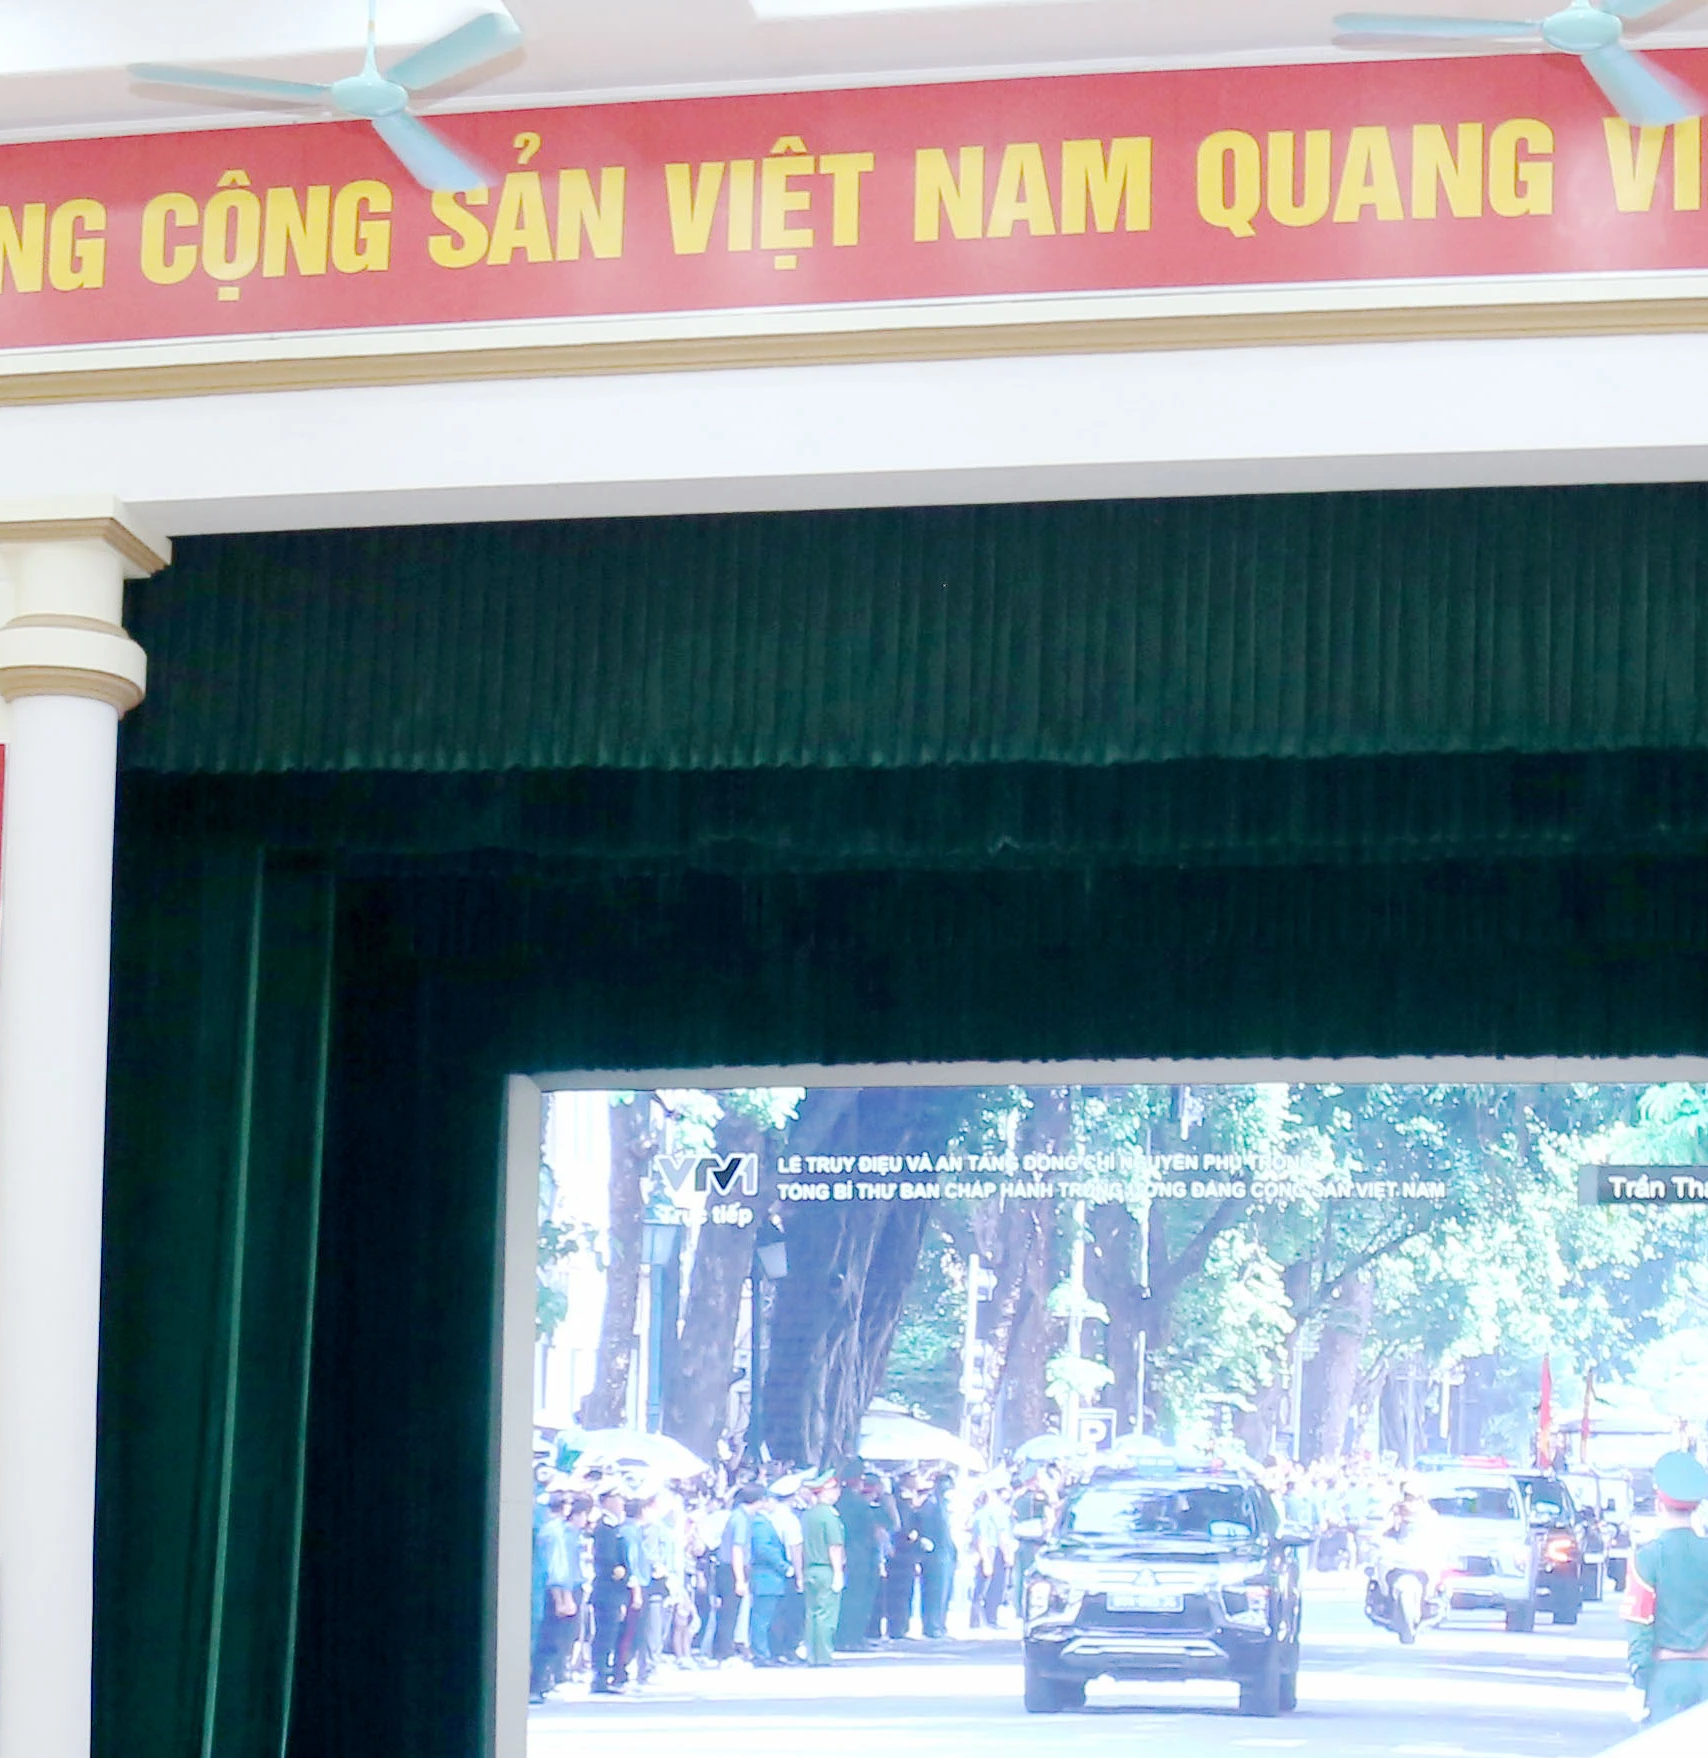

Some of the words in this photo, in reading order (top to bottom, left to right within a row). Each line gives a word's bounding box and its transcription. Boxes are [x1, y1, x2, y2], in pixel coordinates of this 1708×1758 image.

[140, 170, 392, 301] CỘNG
[428, 132, 626, 268] SẢN
[665, 136, 874, 270] VIỆT
[914, 137, 1151, 242] NAM
[1197, 119, 1555, 237] QUANG
[805, 1156, 856, 1173] TRUY
[857, 1156, 904, 1175] ĐIỆU
[935, 1156, 962, 1171] AN
[856, 1183, 897, 1200] THƯ
[900, 1183, 940, 1199] BAN
